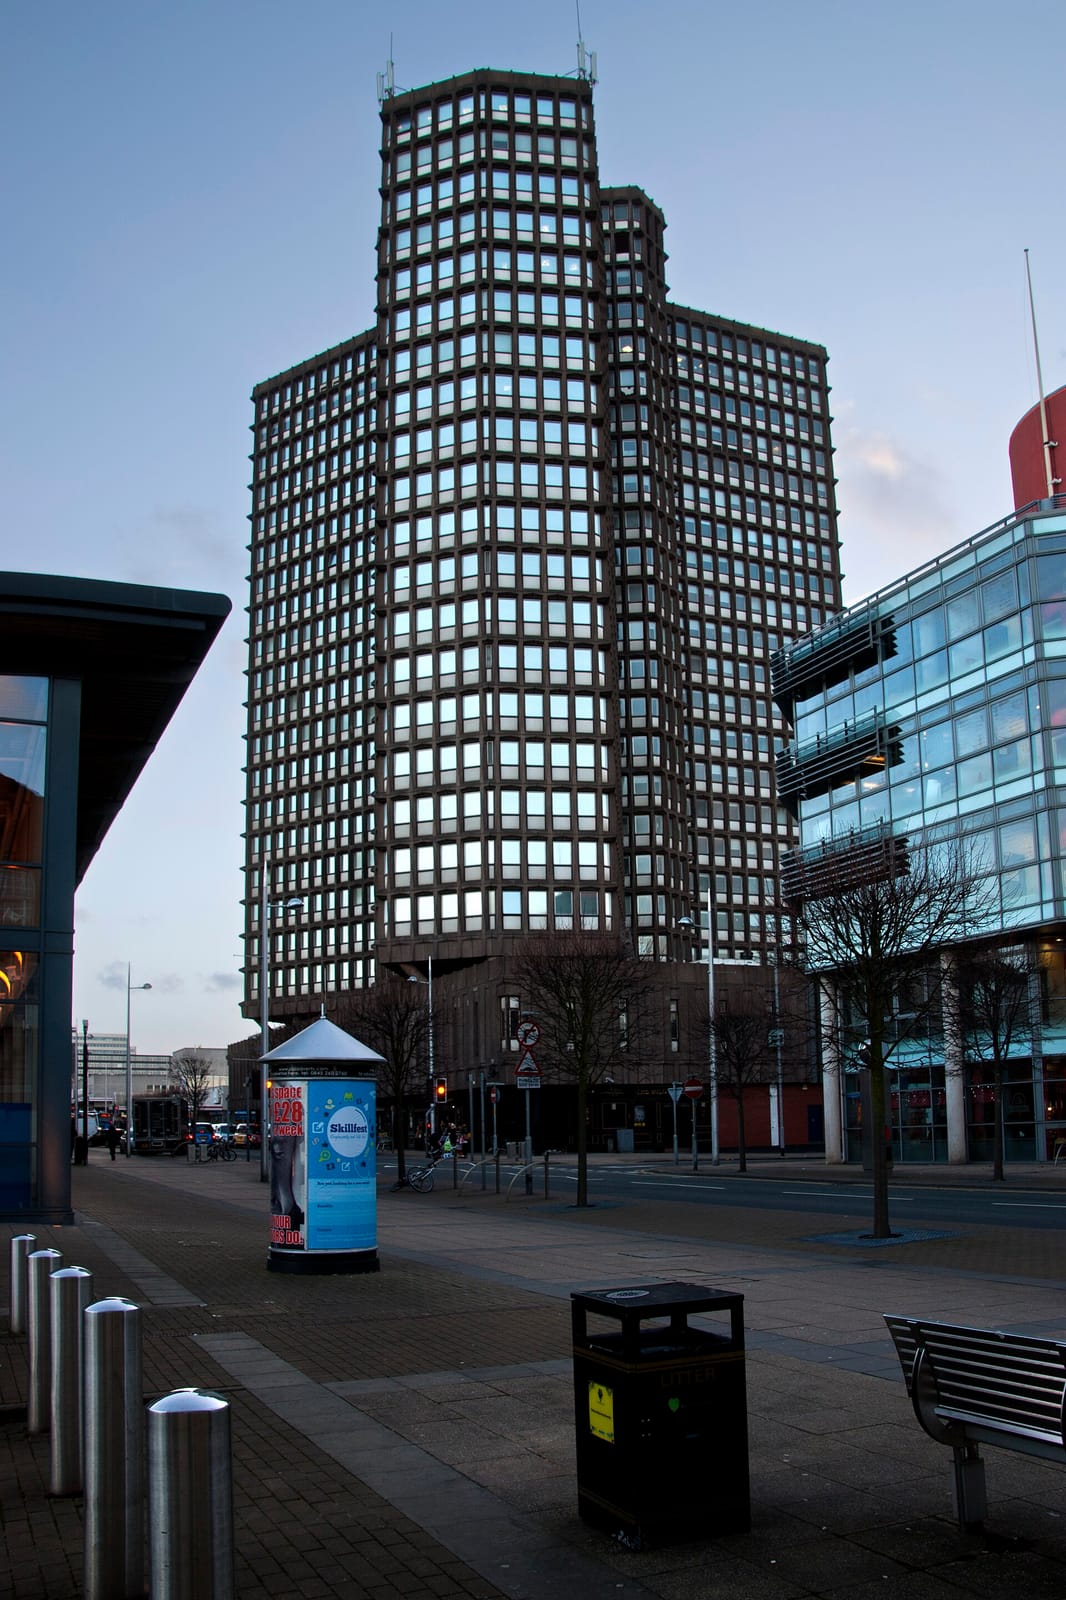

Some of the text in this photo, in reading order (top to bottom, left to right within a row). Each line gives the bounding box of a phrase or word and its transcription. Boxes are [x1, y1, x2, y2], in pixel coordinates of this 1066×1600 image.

[275, 1087, 302, 1099] space
[274, 1101, 303, 1123] £28
[279, 1124, 304, 1136] week
[330, 1123, 368, 1133] Skillfest
[661, 1366, 718, 1388] LITTER
